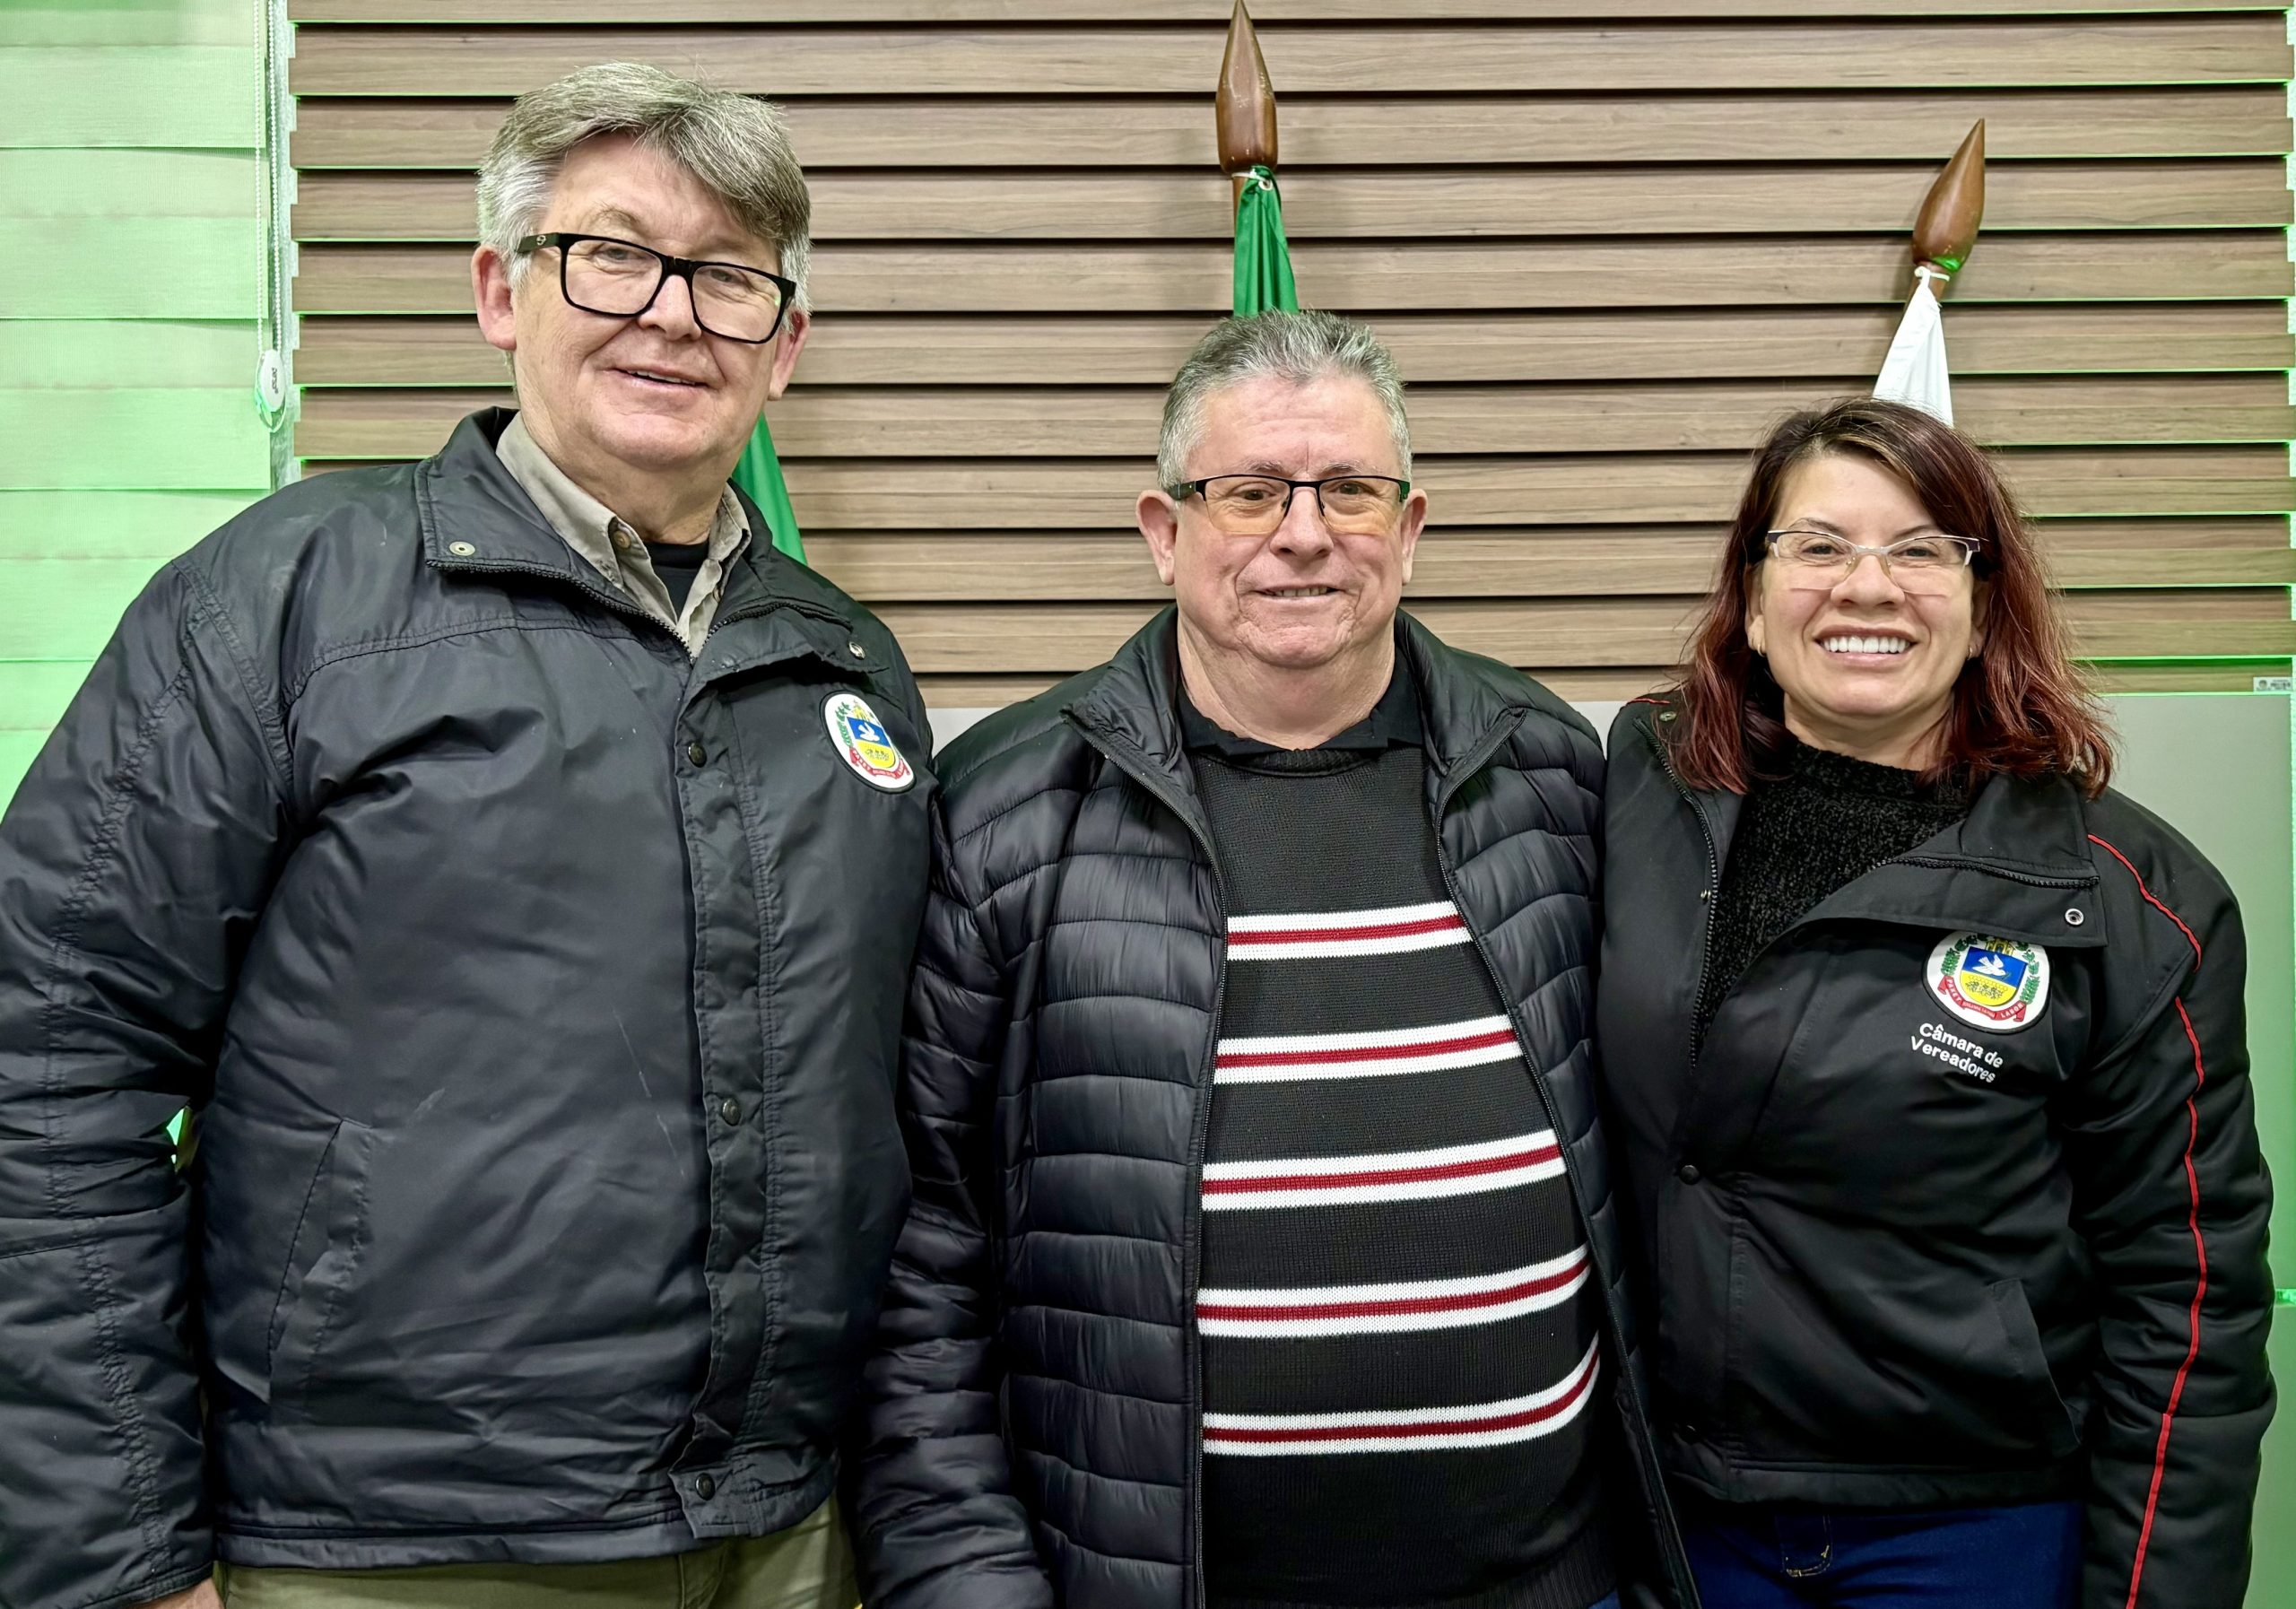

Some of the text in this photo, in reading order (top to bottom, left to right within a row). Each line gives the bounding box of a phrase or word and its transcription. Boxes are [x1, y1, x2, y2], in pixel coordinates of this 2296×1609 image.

[1910, 1036, 1996, 1083] Vereadores
[1918, 1022, 2004, 1068] Câmara de
